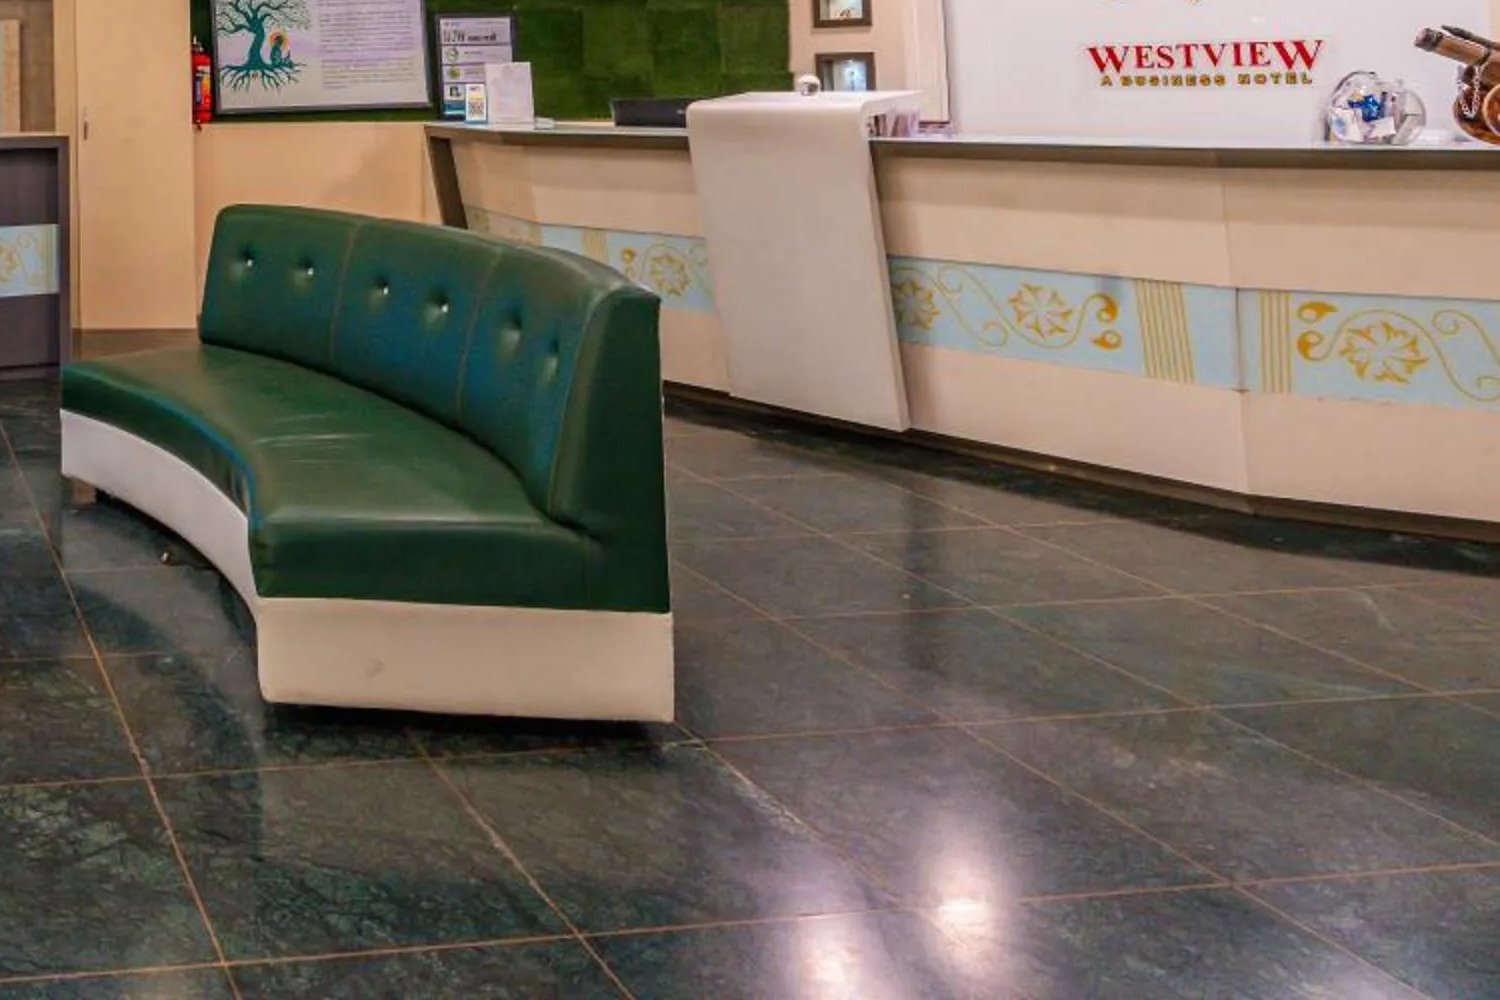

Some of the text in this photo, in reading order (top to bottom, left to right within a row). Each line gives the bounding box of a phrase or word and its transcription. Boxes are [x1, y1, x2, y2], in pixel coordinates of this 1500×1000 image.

[1087, 39, 1323, 73] WESTVIEW
[1101, 71, 1313, 87] A BUSINESS HOTEL
